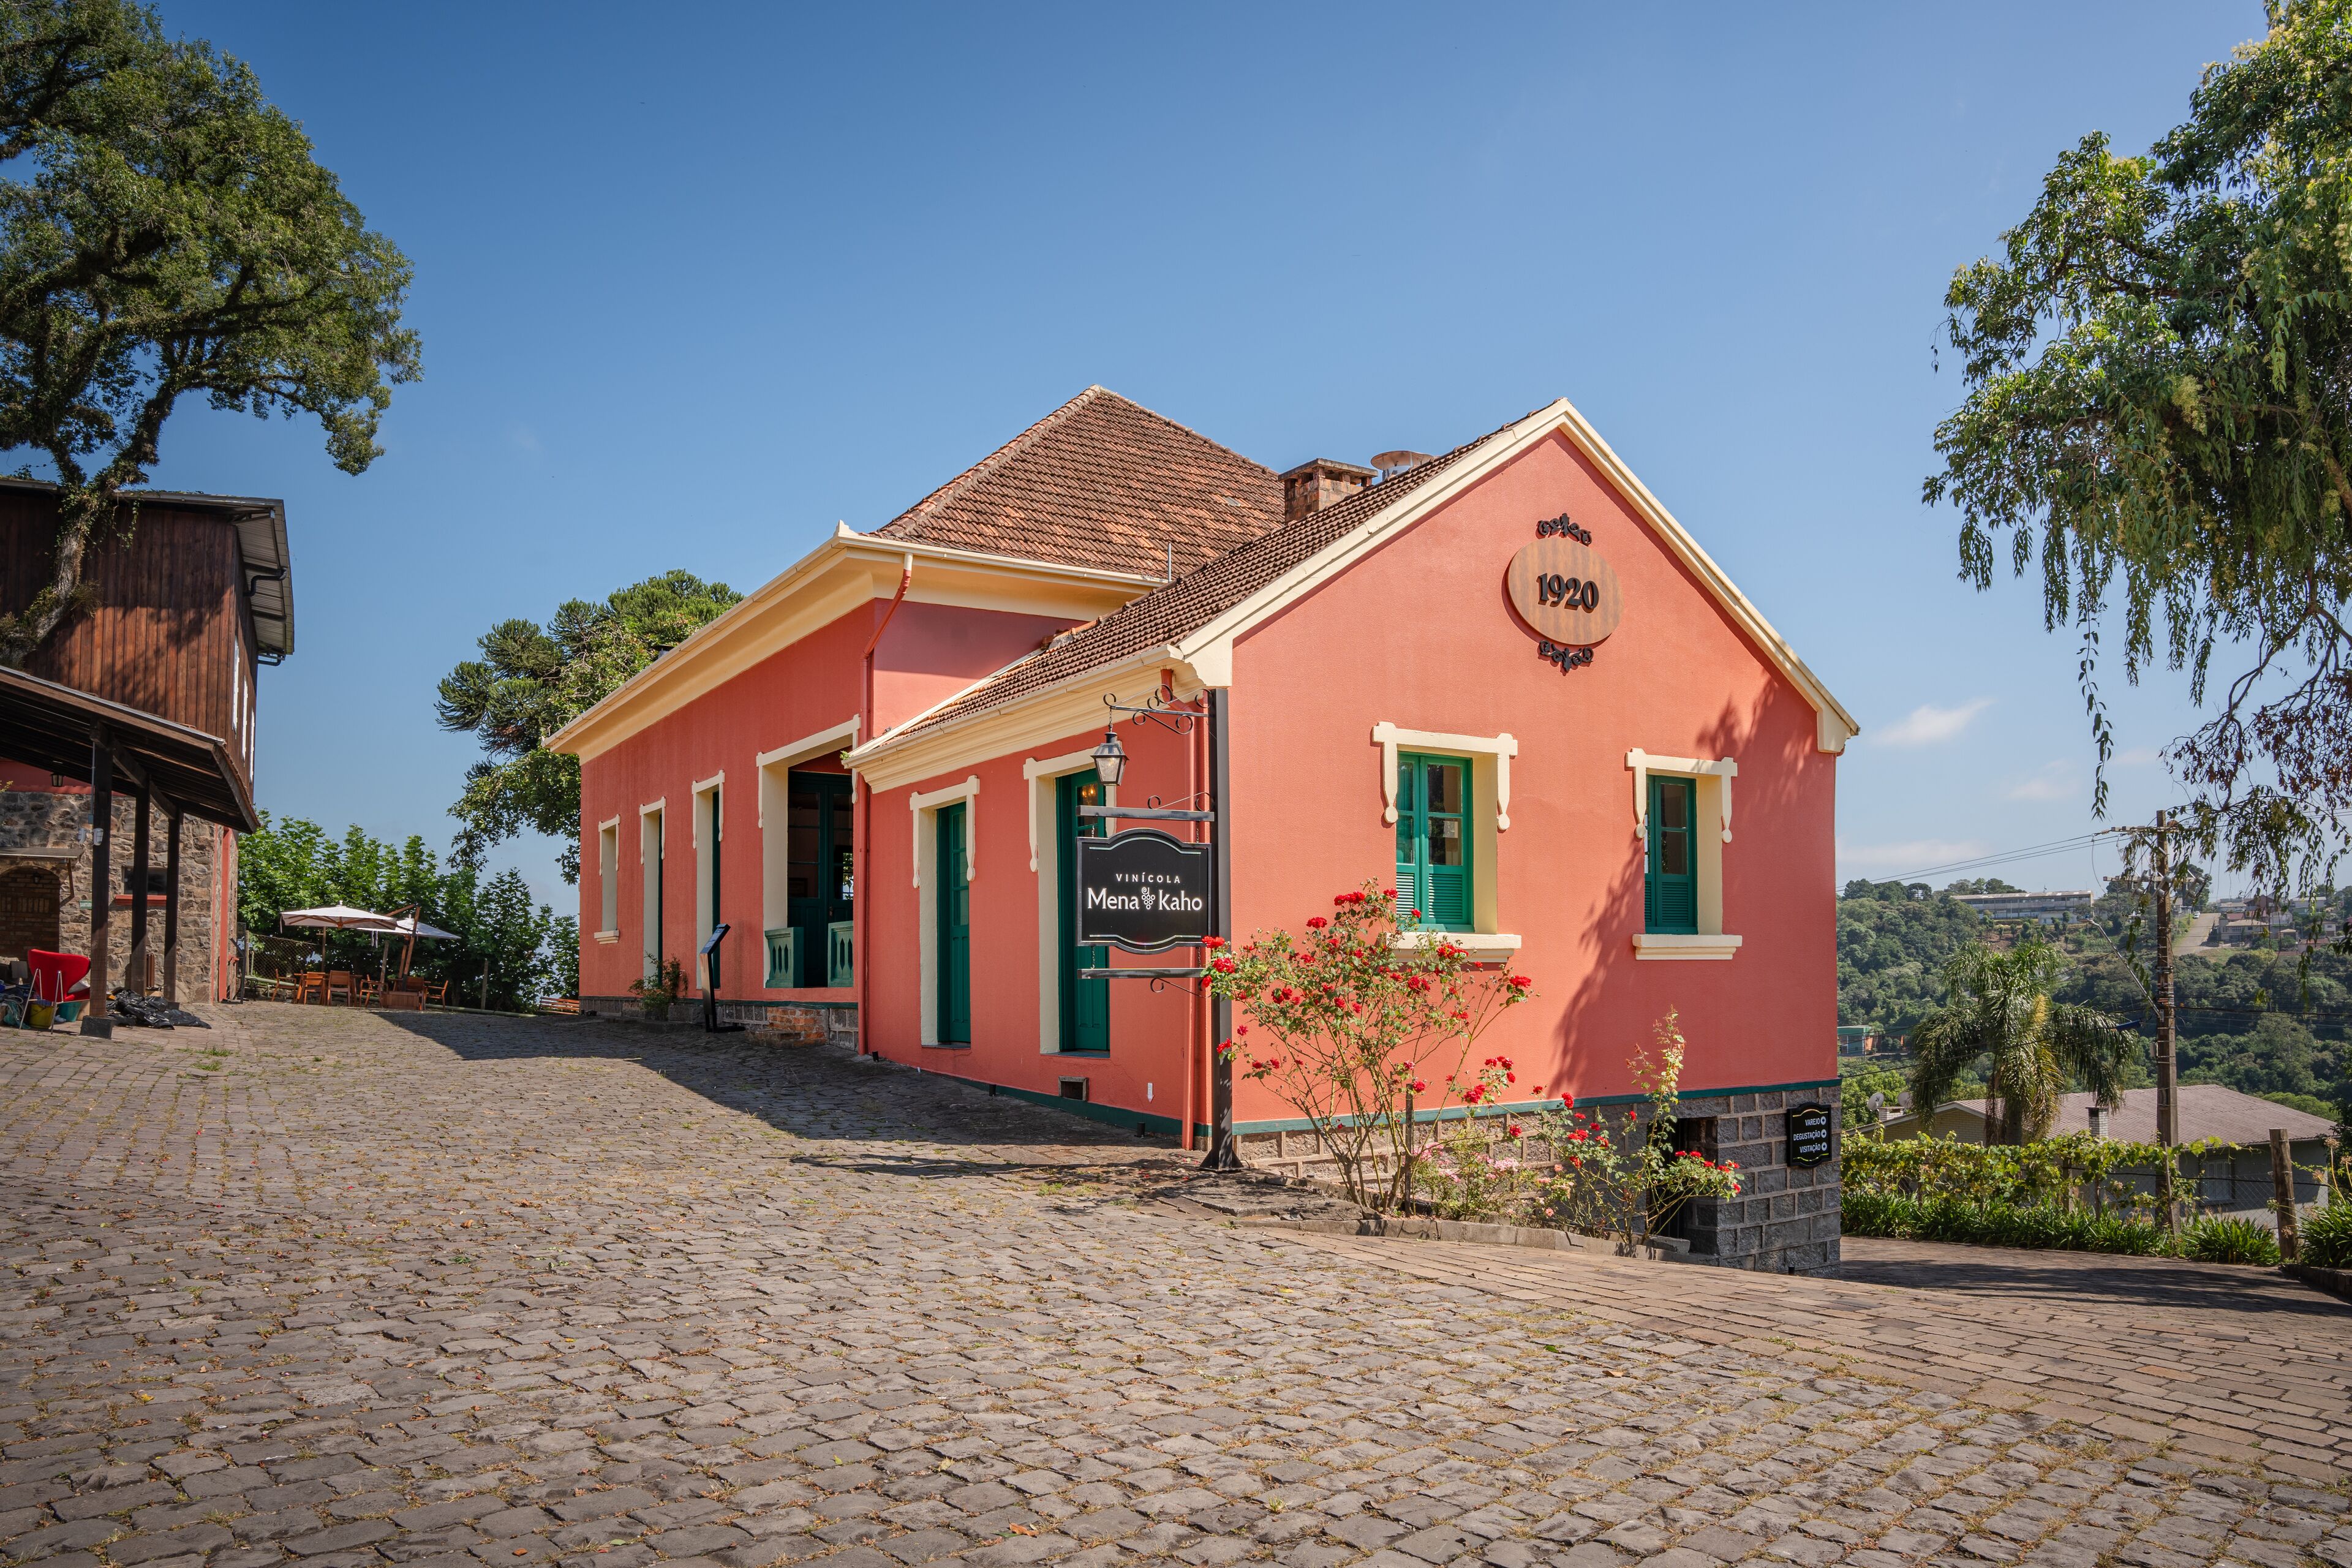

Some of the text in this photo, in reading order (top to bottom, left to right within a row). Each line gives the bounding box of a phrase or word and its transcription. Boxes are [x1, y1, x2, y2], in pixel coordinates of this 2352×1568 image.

[1537, 573, 1599, 609] 1920
[1116, 872, 1180, 883] VINÍCOLA
[1087, 888, 1140, 910] Mena
[1793, 1130, 1820, 1140] DEGUSTAÇÃO
[1800, 1143, 1820, 1153] VISITAÇÃO
